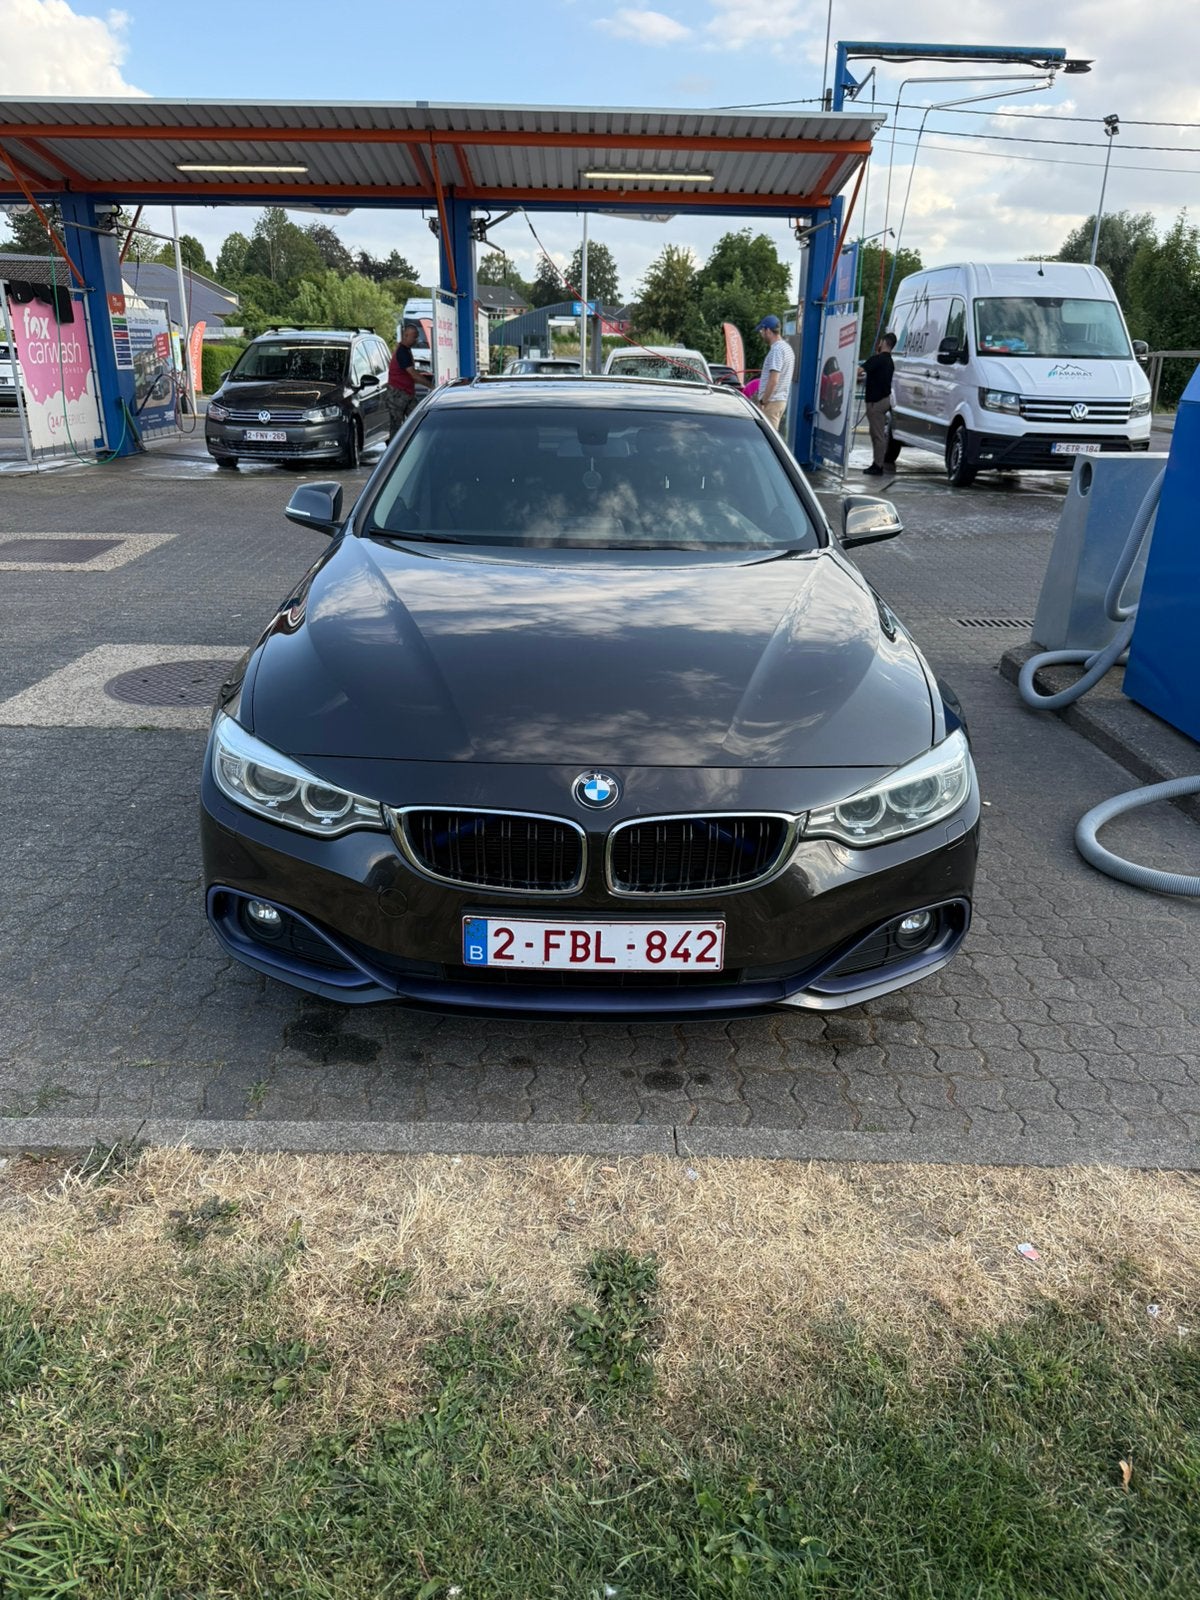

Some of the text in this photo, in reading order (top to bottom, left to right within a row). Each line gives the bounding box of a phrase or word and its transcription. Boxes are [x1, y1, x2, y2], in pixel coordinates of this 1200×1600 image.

[24, 307, 51, 340] fox
[28, 333, 82, 364] carwash
[903, 332, 930, 354] ARARAT
[65, 413, 88, 426] ERVICE
[1056, 443, 1098, 453] 2-ETR-184
[580, 773, 616, 786] BMW
[469, 927, 718, 964] B 2-FBL-842
